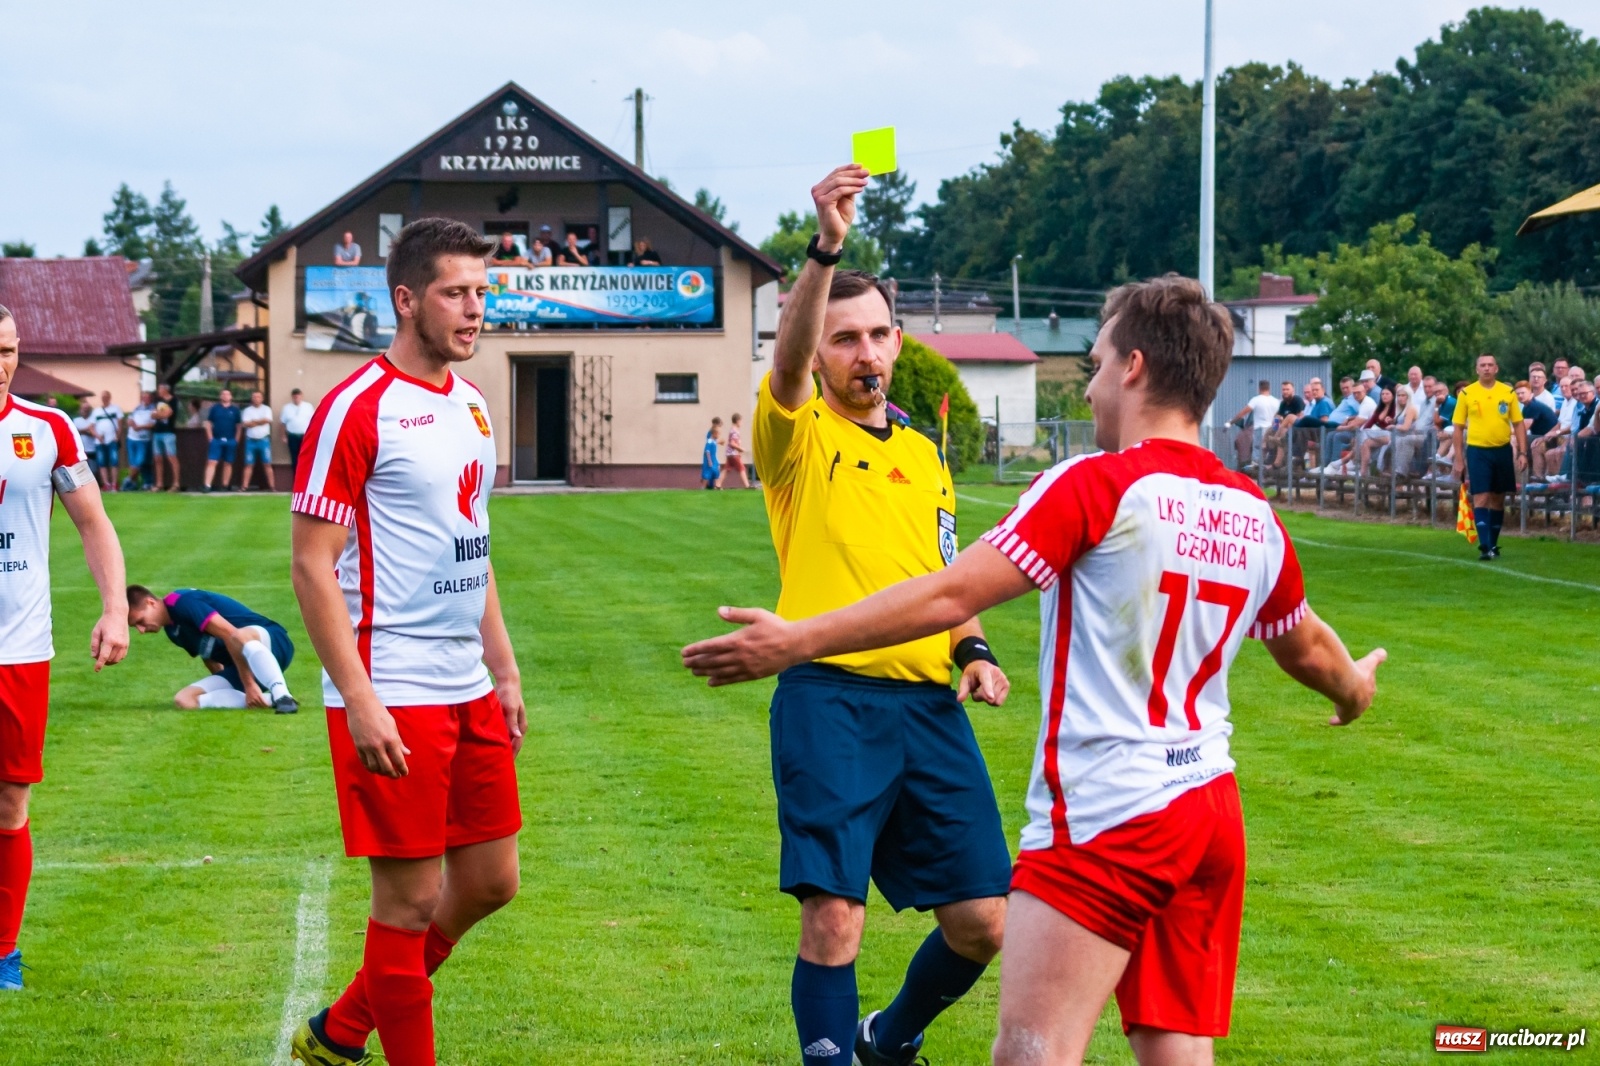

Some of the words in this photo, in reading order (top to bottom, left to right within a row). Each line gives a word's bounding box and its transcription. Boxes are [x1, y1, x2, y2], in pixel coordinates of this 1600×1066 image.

[496, 116, 529, 130] LKS
[484, 135, 539, 150] 1920
[440, 152, 581, 170] KRZYŻANOWICE
[516, 275, 545, 291] LKS
[550, 271, 674, 291] KRZYŻANOWICE
[606, 294, 676, 308] 1920-2020
[1158, 496, 1185, 525] LKS
[433, 575, 480, 595] GALERIA
[1147, 570, 1250, 731] 17
